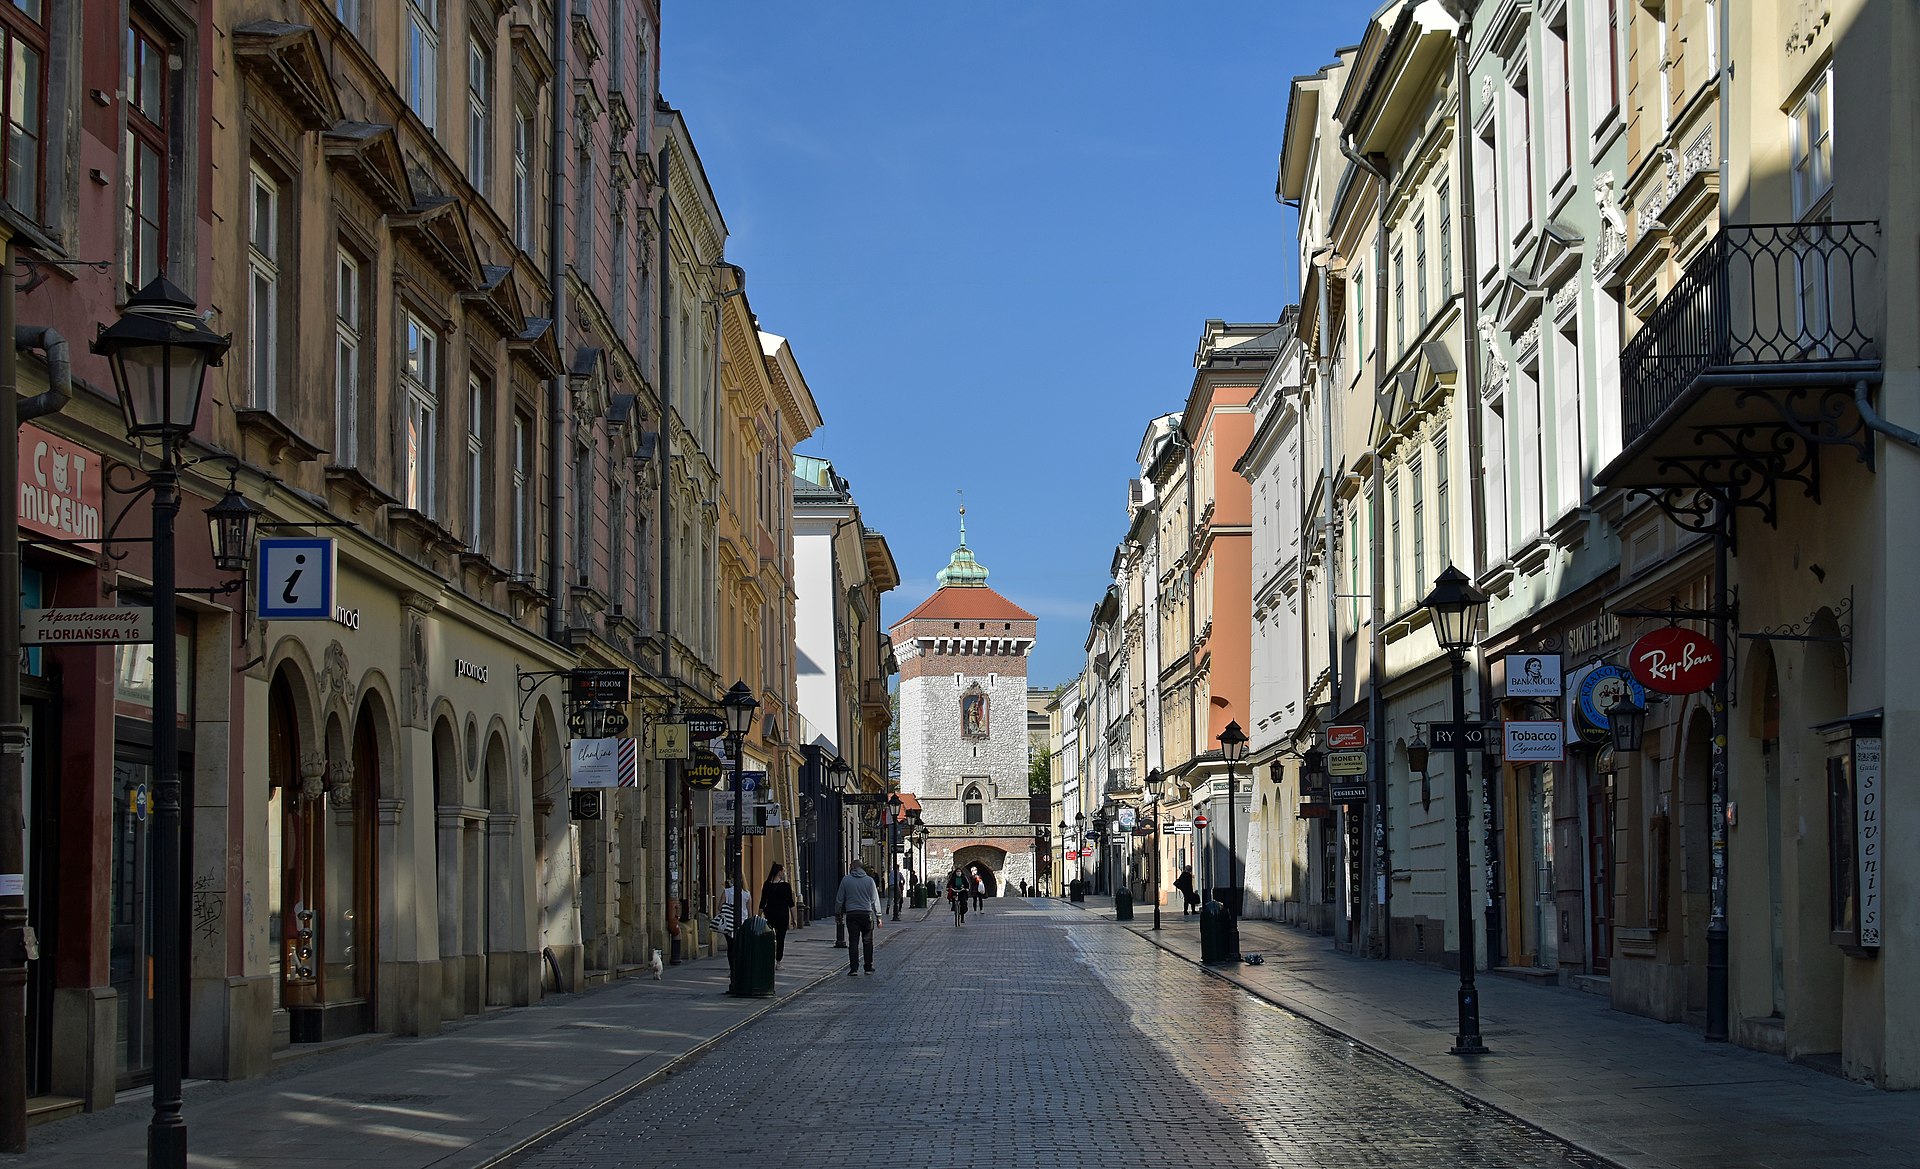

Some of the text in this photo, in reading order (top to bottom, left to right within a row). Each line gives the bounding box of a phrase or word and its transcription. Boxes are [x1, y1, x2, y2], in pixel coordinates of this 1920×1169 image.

[20, 482, 99, 541] MUSEUM
[39, 609, 140, 625] Apartamenty
[38, 626, 139, 640] FLORIAŃSKA 16
[457, 658, 488, 683] promod
[600, 680, 621, 688] ROOM
[1510, 730, 1557, 742] Tobacco
[1511, 741, 1556, 755] Cigarettes
[1333, 789, 1365, 797] CEGIELNIA
[1863, 776, 1878, 924] souvenirs
[1351, 814, 1361, 905] CONVERSE
